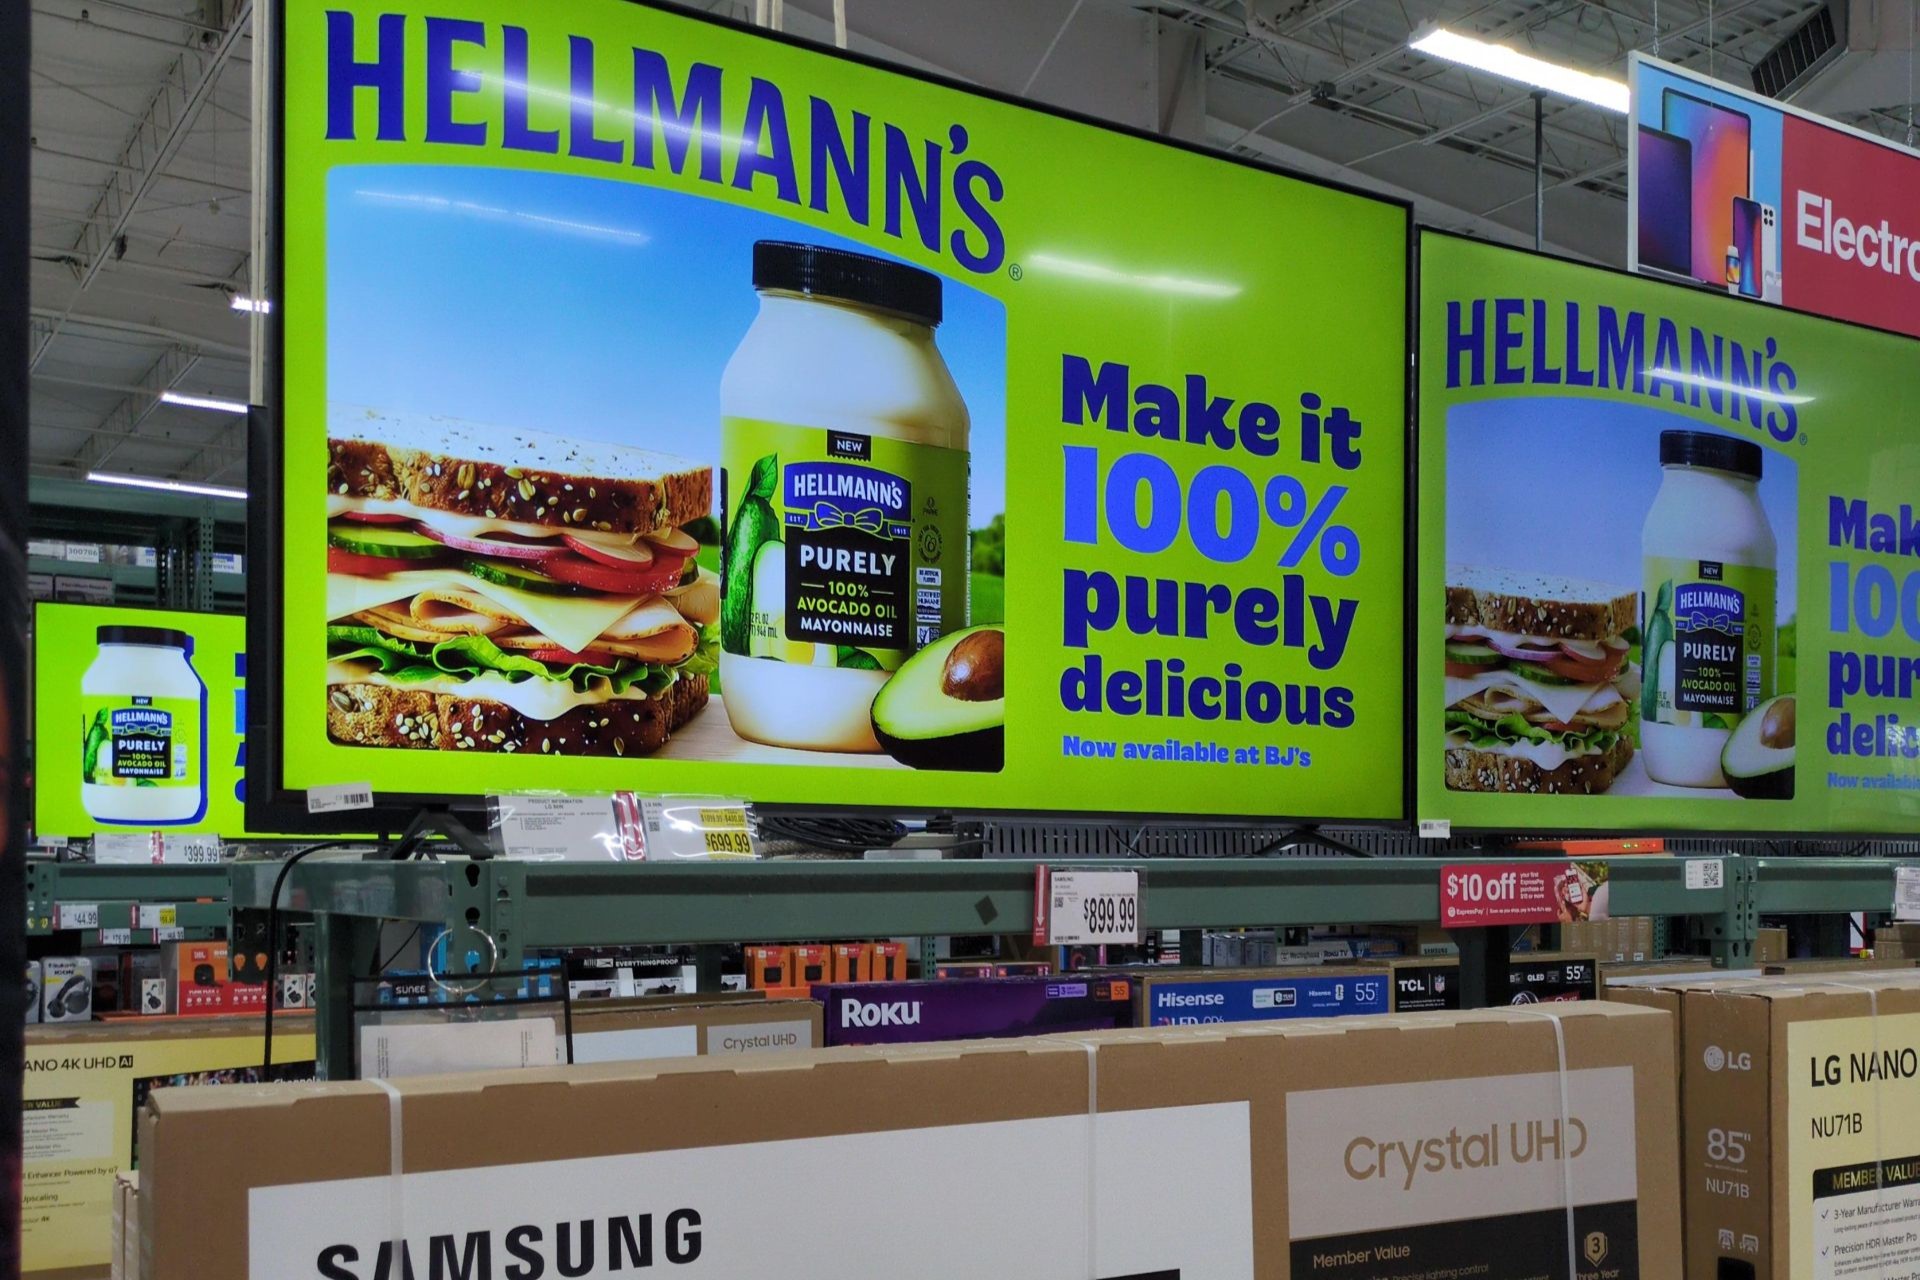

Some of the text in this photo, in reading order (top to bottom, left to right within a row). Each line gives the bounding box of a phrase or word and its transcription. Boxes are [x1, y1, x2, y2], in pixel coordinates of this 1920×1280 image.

[325, 10, 1006, 273] HELLMANN'S
[1446, 298, 1798, 443] HELLMANN'S
[1062, 353, 1362, 471] Make it
[836, 439, 863, 453] NEW
[794, 473, 903, 509] HELLMANN'S
[1062, 445, 1361, 578] 100%
[800, 544, 896, 576] PURELY
[1703, 566, 1719, 576] NEW
[828, 580, 869, 598] 100%
[797, 596, 870, 617] AVOCADO
[875, 604, 898, 619] OIL
[1680, 591, 1741, 615] HELLMANN'S
[801, 616, 893, 638] MAYONNAISE
[1062, 568, 1360, 670] purely
[1683, 642, 1737, 661] PURELY
[1698, 667, 1721, 677] 100%
[1060, 654, 1355, 728] delicious
[1681, 679, 1736, 691] AVOCADO OIL
[1683, 693, 1734, 705] MAYONNAISE
[115, 711, 168, 725] HELLMANN'S
[118, 740, 165, 751] PURELY
[1063, 735, 1311, 768] Now available at BJ's
[184, 845, 218, 862] $399.99
[705, 833, 751, 853] $699.99
[1447, 872, 1516, 901] $10 off
[74, 912, 97, 925] $44.99
[1084, 897, 1135, 934] $899.99
[1398, 979, 1425, 992] TCL
[1158, 993, 1225, 1008] Hisense
[723, 1033, 797, 1052] Crystal UHD
[60, 1058, 80, 1071] 4K
[84, 1056, 116, 1070] UHD
[121, 1055, 133, 1067] AI
[1728, 1053, 1751, 1070] LG
[1811, 1048, 1917, 1087] LG NANO
[1811, 1113, 1863, 1139] NU71B
[1343, 1117, 1587, 1191] Crystal UHD
[1706, 1177, 1750, 1199] NU71B
[1833, 1167, 1882, 1190] MEMBER
[1834, 1208, 1855, 1220] 3-Year
[1857, 1202, 1902, 1216] Manufacturer
[1593, 1236, 1601, 1254] 3
[1834, 1241, 1864, 1256] Precision
[1865, 1238, 1881, 1249] HDR
[1906, 1232, 1917, 1243] Pro
[1313, 1245, 1411, 1270] Member Value
[1426, 1267, 1458, 1280] lighting
[1459, 1264, 1489, 1276] control
